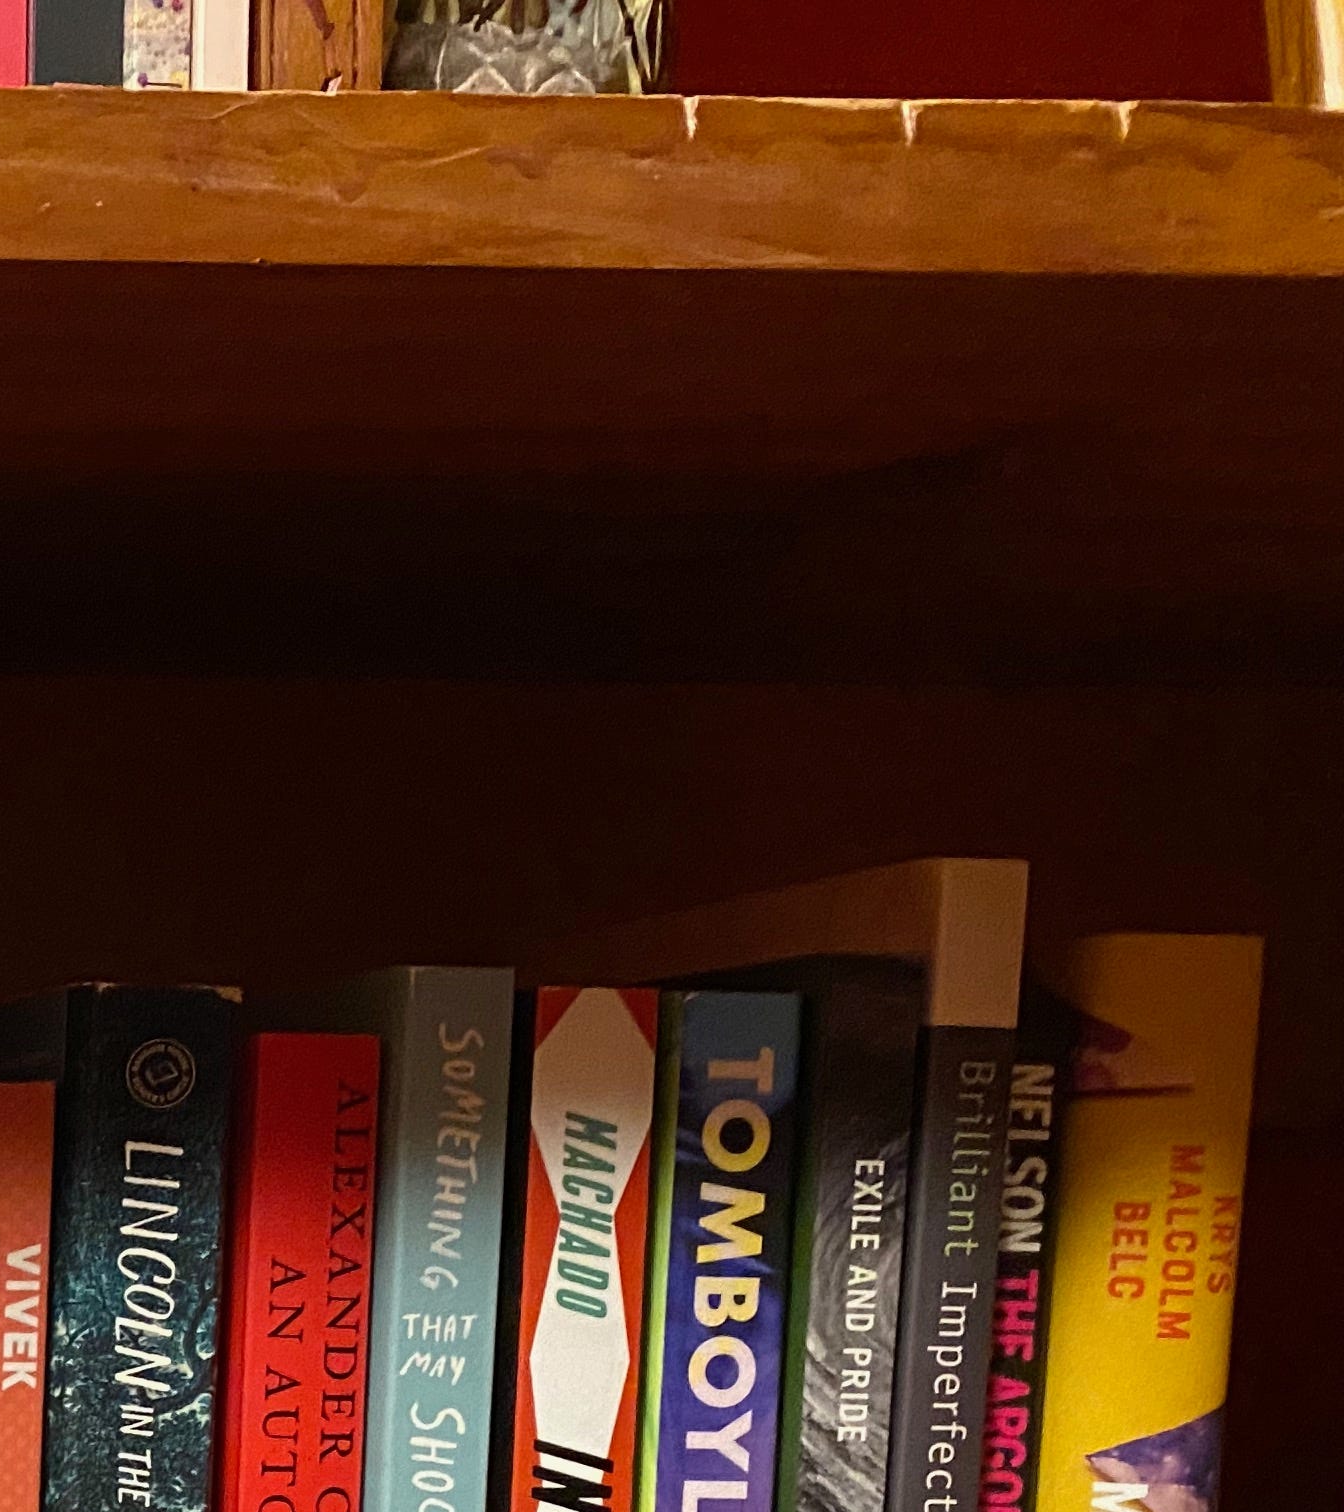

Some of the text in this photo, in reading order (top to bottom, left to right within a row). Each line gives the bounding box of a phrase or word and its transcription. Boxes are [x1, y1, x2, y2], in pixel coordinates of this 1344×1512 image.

[419, 1022, 484, 1291] SOMETHING
[555, 1110, 619, 1319] MACHADO
[943, 1059, 998, 1258] Brilliant
[1156, 1143, 1206, 1343] MALCOLM
[2, 1243, 42, 1391] VIVEK
[113, 1140, 184, 1393] LINCOLN
[268, 1257, 308, 1344] AN
[318, 1081, 372, 1462] ALEXANDER
[402, 1313, 477, 1341] THAT
[837, 1157, 886, 1443] EXILE AND PRIDE
[1107, 1200, 1151, 1302] BELC
[117, 1403, 154, 1437] IN
[399, 1351, 467, 1386] MAY
[116, 1448, 153, 1508] THE
